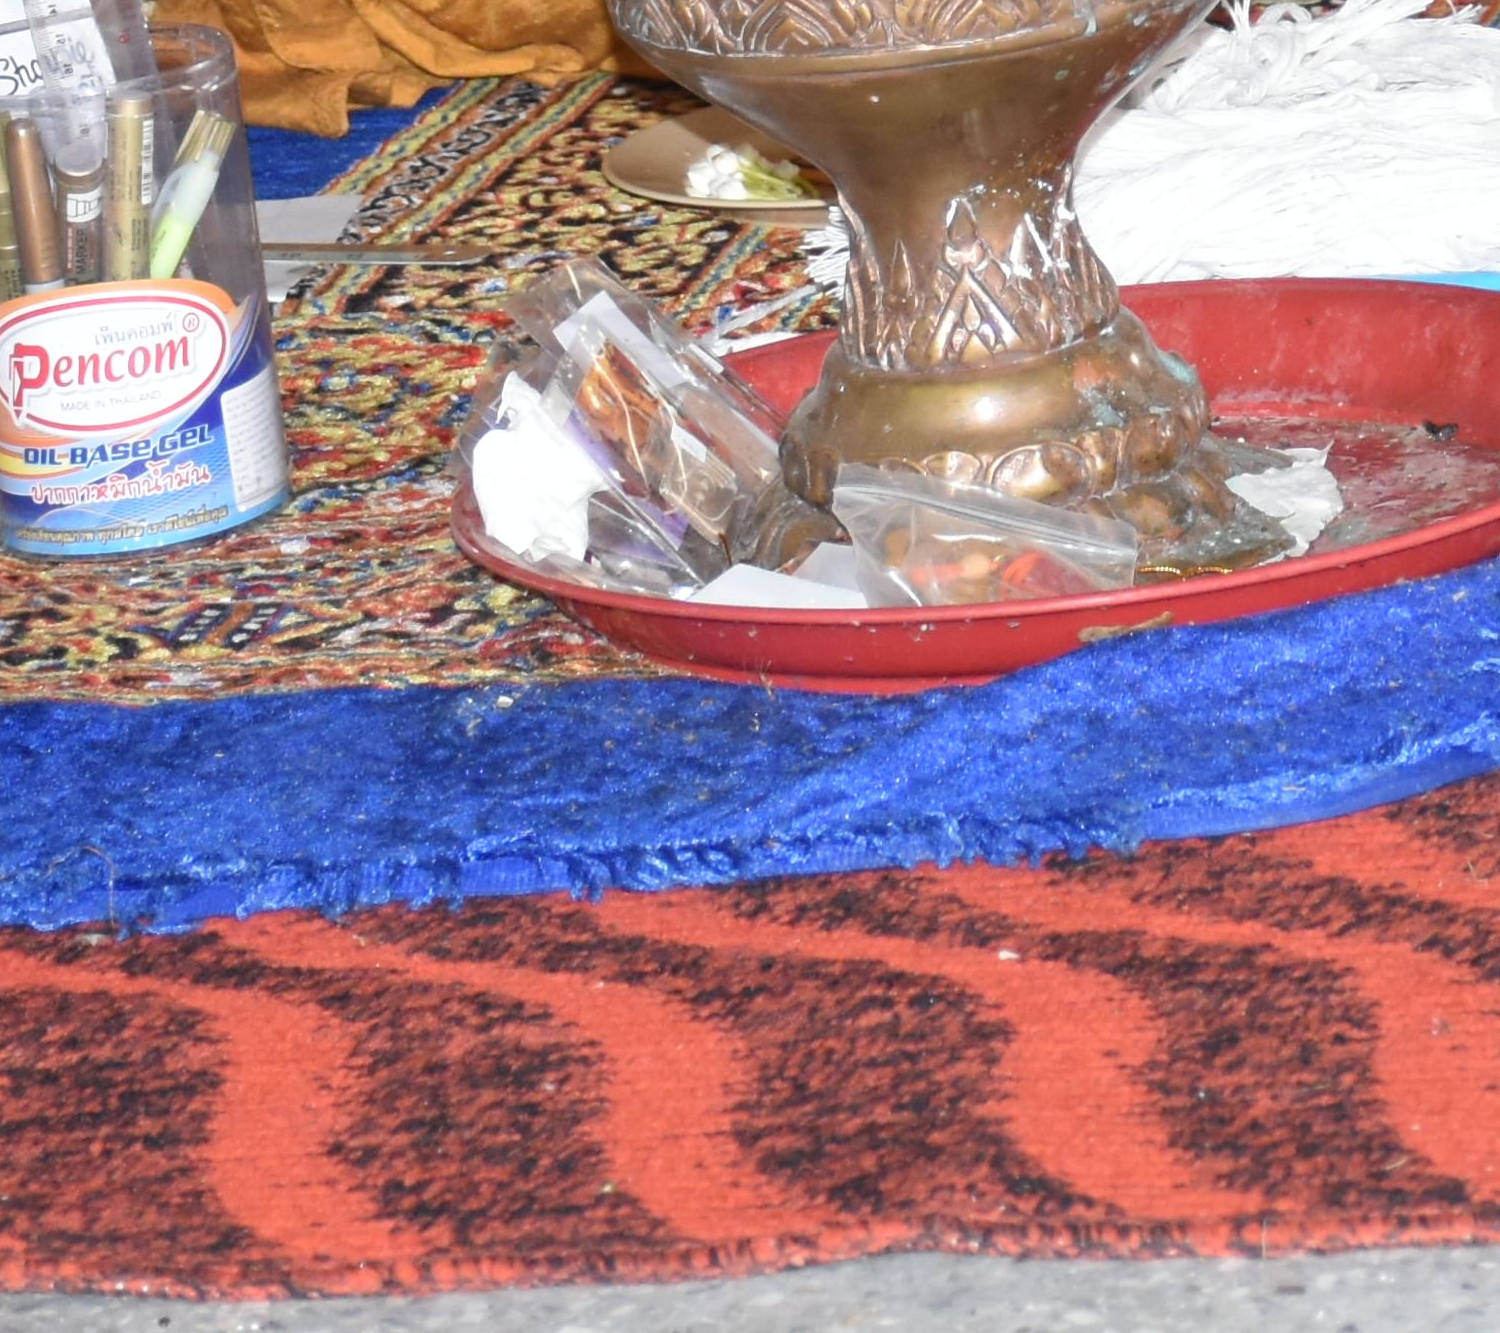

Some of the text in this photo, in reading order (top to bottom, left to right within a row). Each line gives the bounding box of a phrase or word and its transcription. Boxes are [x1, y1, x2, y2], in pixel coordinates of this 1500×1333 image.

[75, 228, 87, 275] MARKER
[9, 335, 190, 421] Pencom
[60, 389, 162, 412] MADE IN THAILAND
[23, 445, 63, 467] OIL
[31, 458, 211, 506] ปากกาหมึกน้ำมัน
